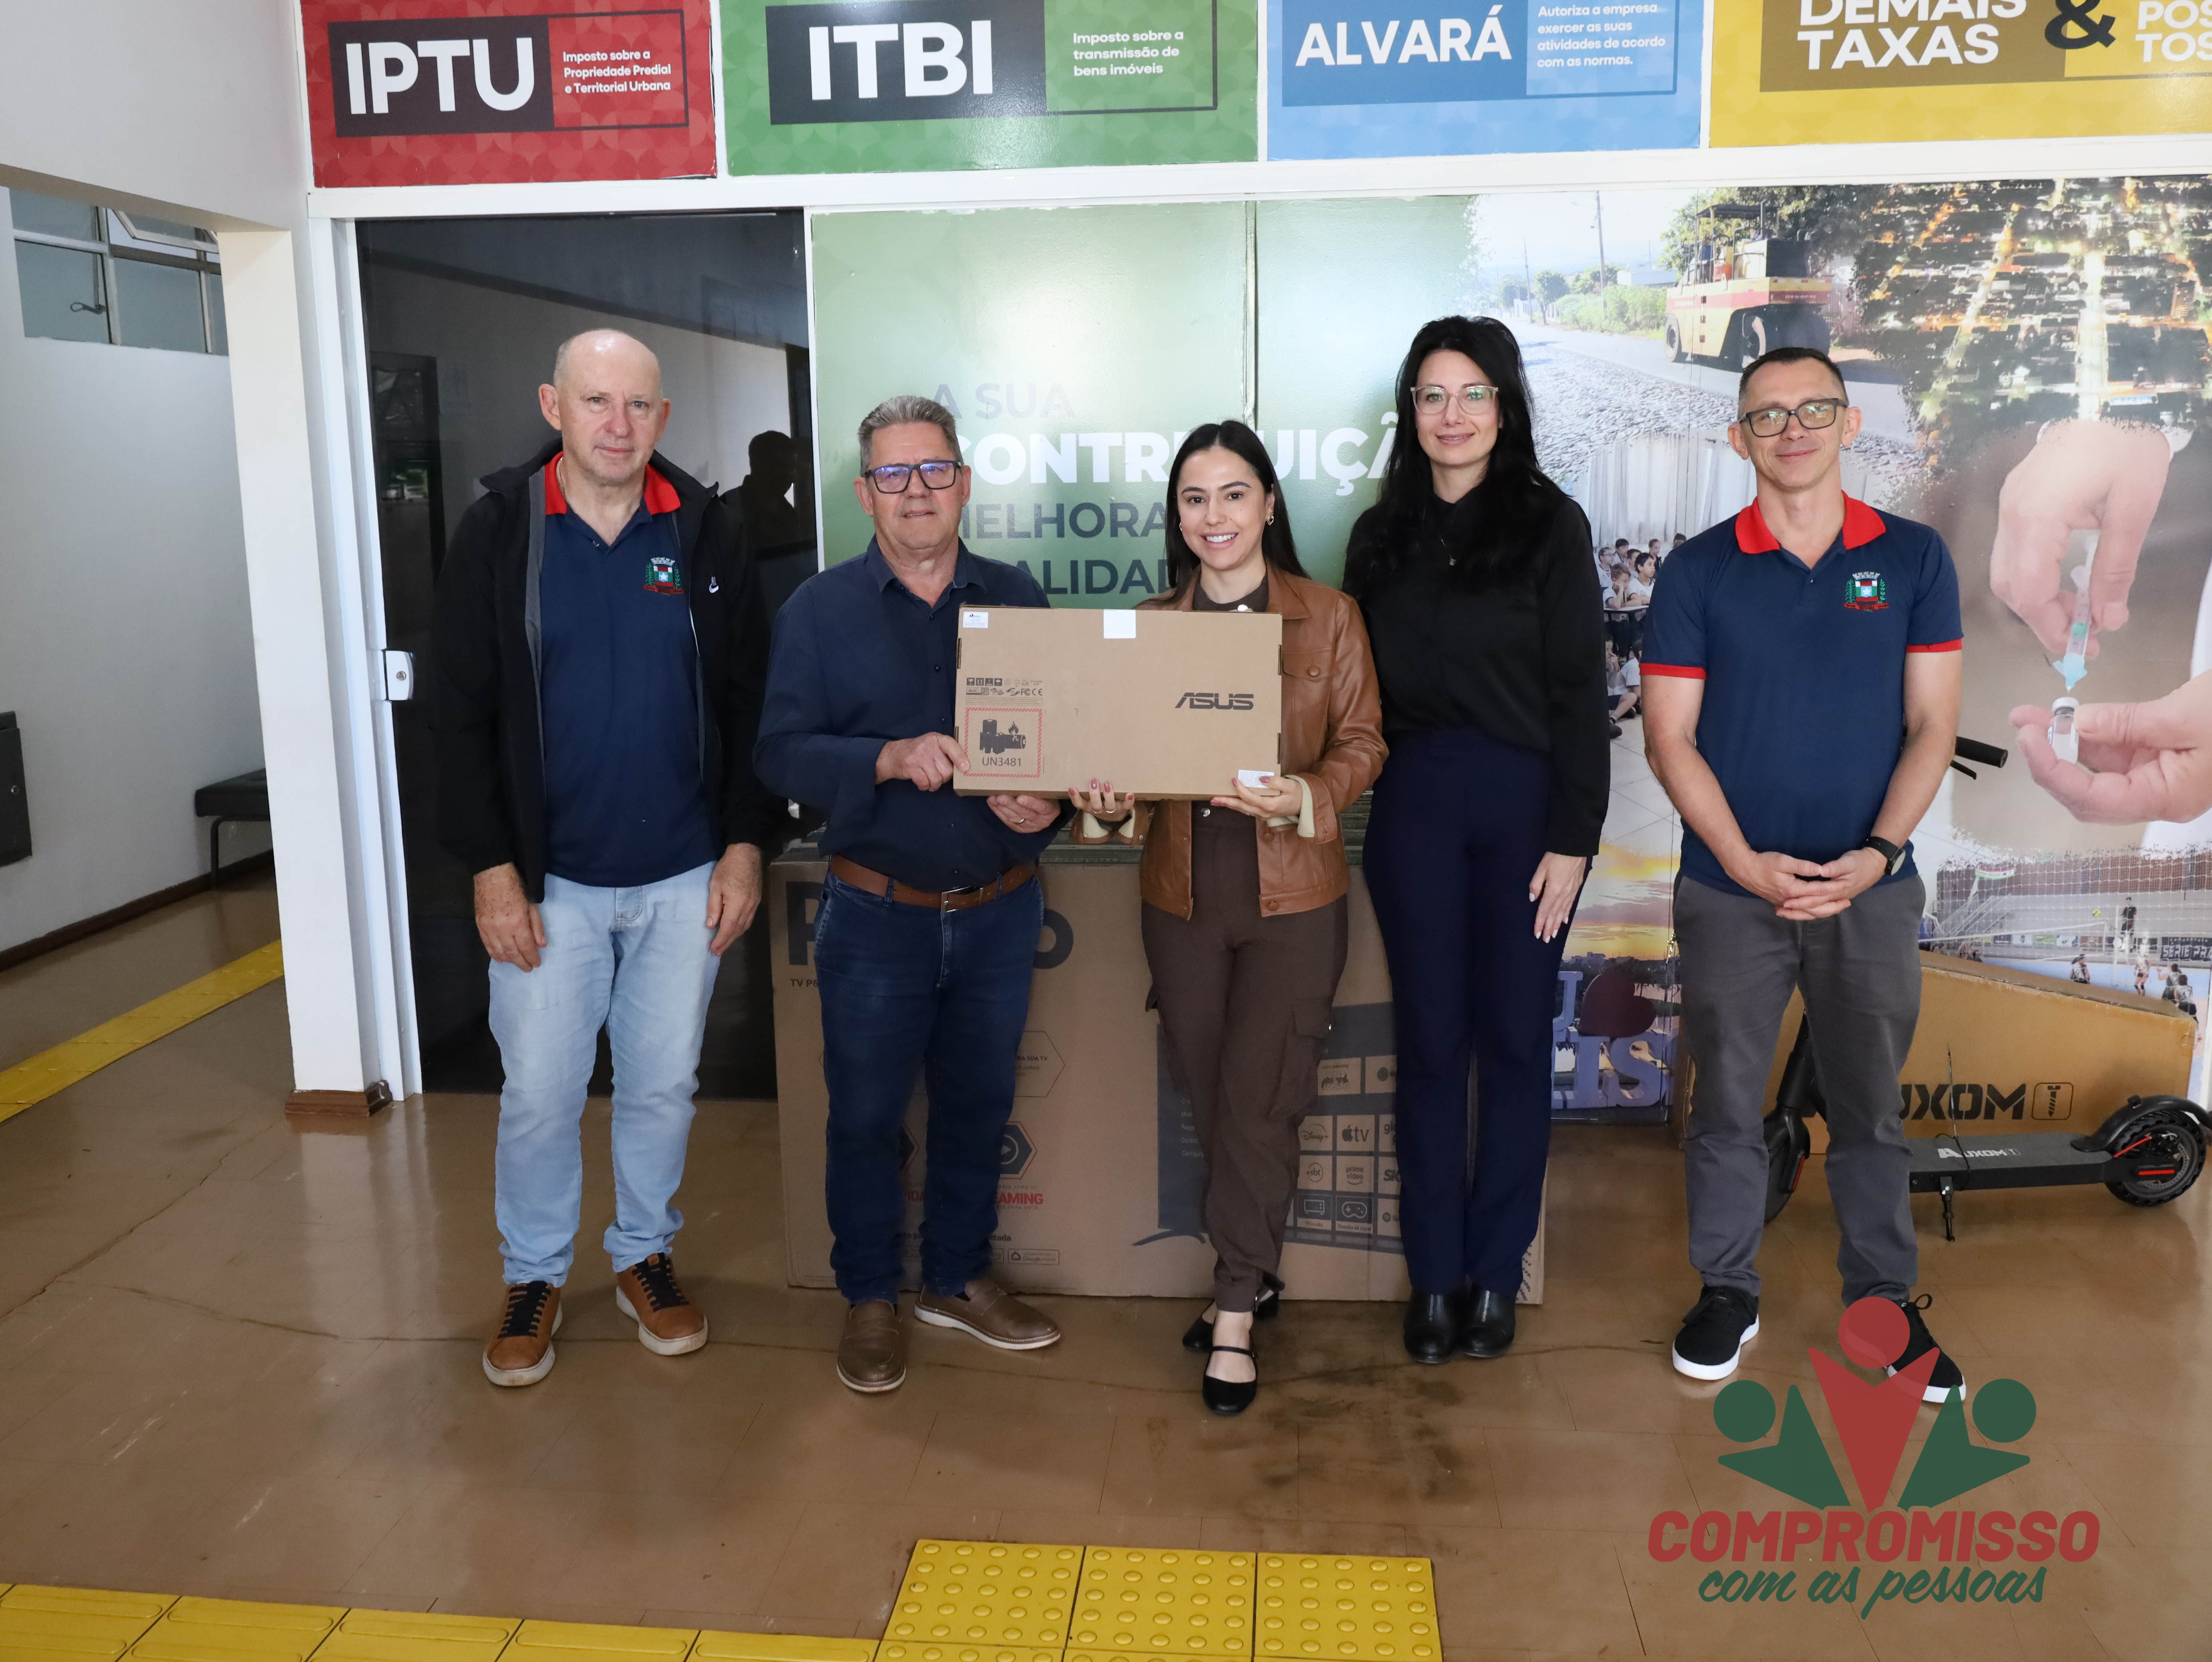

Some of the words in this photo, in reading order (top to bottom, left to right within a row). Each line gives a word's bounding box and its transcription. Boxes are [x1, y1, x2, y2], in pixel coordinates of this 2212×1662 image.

[1538, 5, 1590, 17] Autoriza
[1592, 6, 1601, 15] a
[1603, 4, 1658, 16] empresa
[1295, 4, 1512, 67] ALVARÁ
[1538, 24, 1584, 34] exercer
[1586, 23, 1601, 33] as
[1604, 22, 1633, 32] suas
[1073, 32, 1130, 46] Imposto
[1132, 30, 1172, 41] sobre
[1174, 31, 1184, 40] a
[1537, 38, 1601, 51] atividades
[1603, 38, 1619, 48] de
[1622, 36, 1665, 48] acordo
[1073, 46, 1159, 60] transmissão
[1162, 46, 1180, 57] de
[1797, 24, 1999, 70] TAXAS
[563, 51, 608, 64] Imposto
[610, 50, 641, 60] sobre
[643, 51, 650, 60] a
[809, 20, 993, 101] ITBI
[1537, 58, 1564, 68] com
[1566, 57, 1581, 67] as
[1584, 56, 1633, 66] normas.
[346, 37, 535, 114] IPTU
[564, 65, 631, 80] Propriedade
[633, 64, 671, 76] Predial
[1074, 66, 1107, 76] bens
[1110, 63, 1164, 75] imóveis
[565, 85, 572, 94] e
[573, 81, 627, 93] Territorial
[629, 81, 670, 91] Urbana
[932, 384, 962, 419] A
[975, 383, 1075, 419] SUA
[962, 502, 1167, 539] ELHORA
[1175, 692, 1254, 710] ASUS
[983, 757, 1021, 766] UN3481
[1354, 1126, 1369, 1142] tv
[996, 1192, 1044, 1205] AMING
